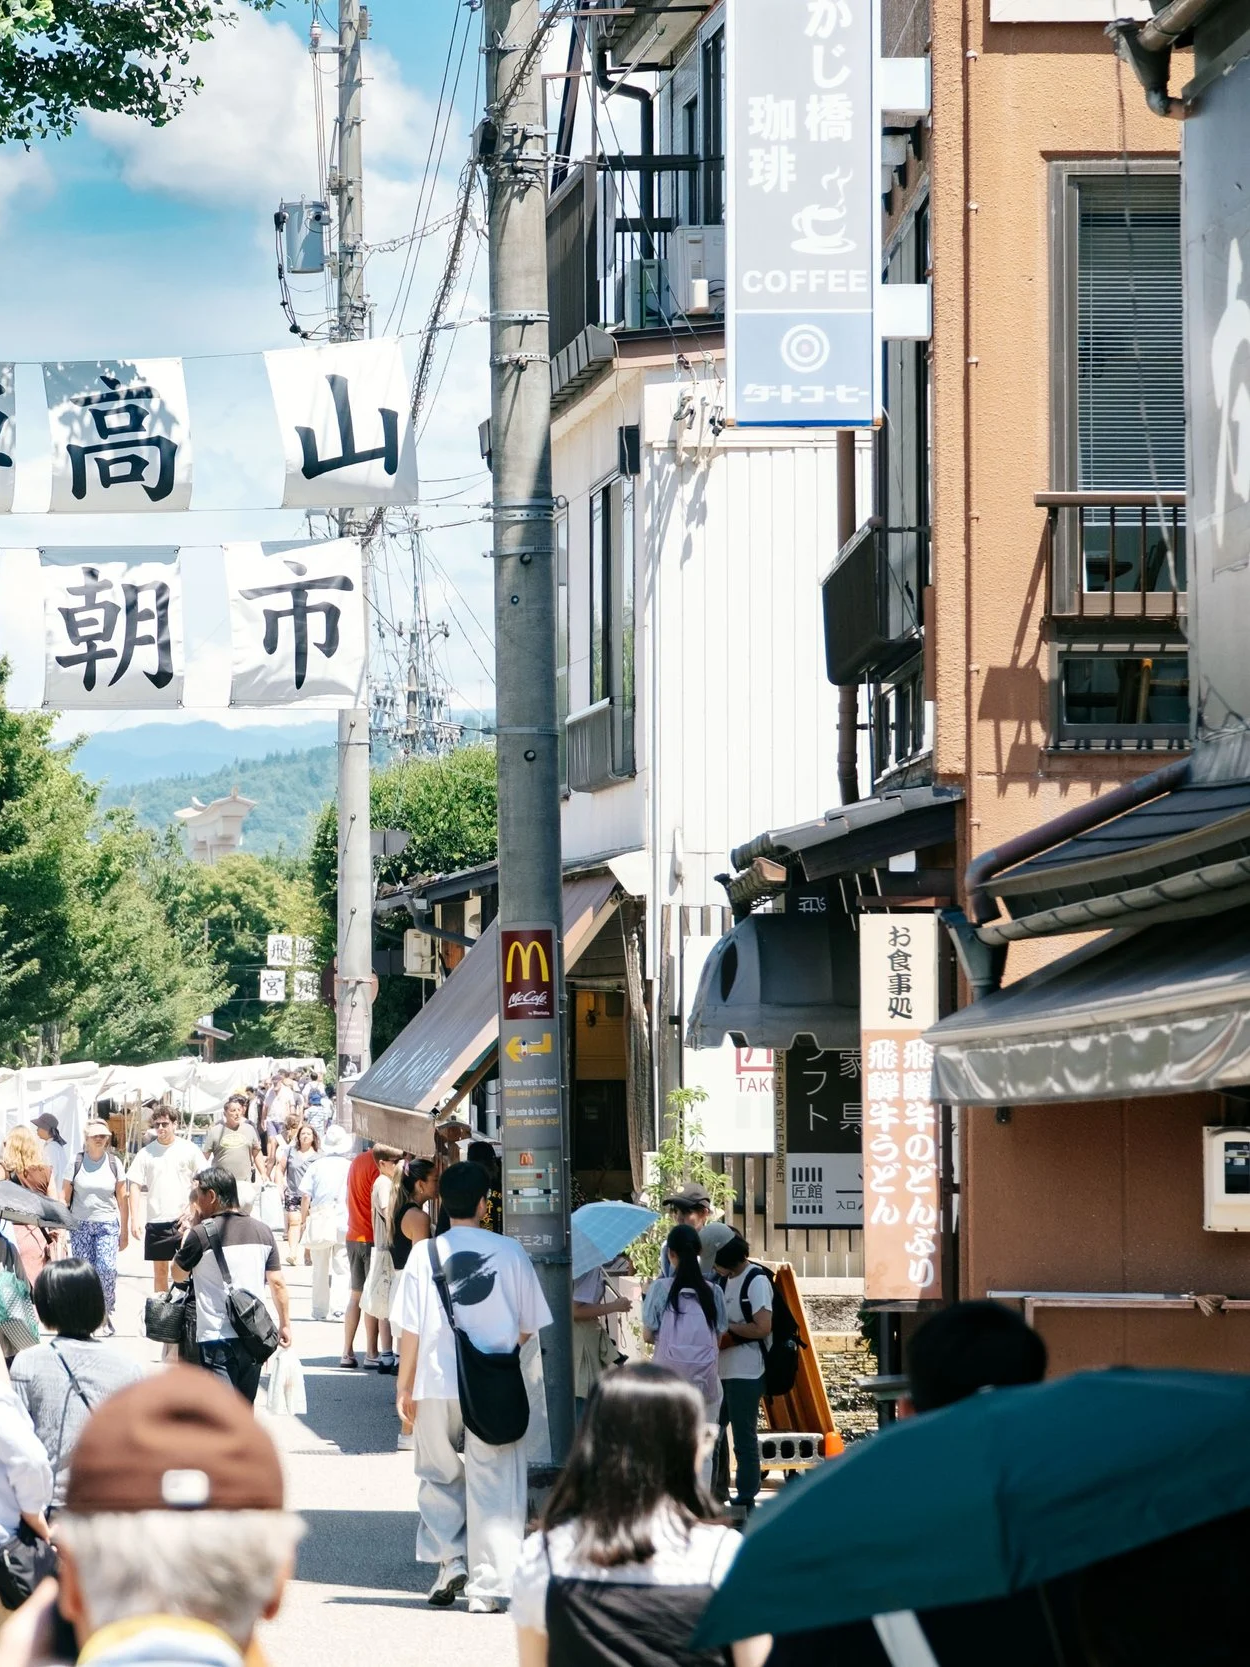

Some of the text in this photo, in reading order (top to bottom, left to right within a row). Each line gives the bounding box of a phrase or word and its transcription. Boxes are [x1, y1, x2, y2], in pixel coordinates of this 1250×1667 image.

[747, 94, 797, 193] 珈琲
[742, 270, 867, 293] COFFEE
[887, 926, 912, 1019] お食事処
[522, 1077, 538, 1086] west
[540, 1076, 558, 1085] street
[736, 1077, 774, 1092] TAK
[775, 1081, 784, 1106] HIDA
[775, 1109, 784, 1140] STYLE
[776, 1144, 785, 1184] MARKET
[792, 1184, 823, 1199] 匠館
[837, 1201, 856, 1210] 入口
